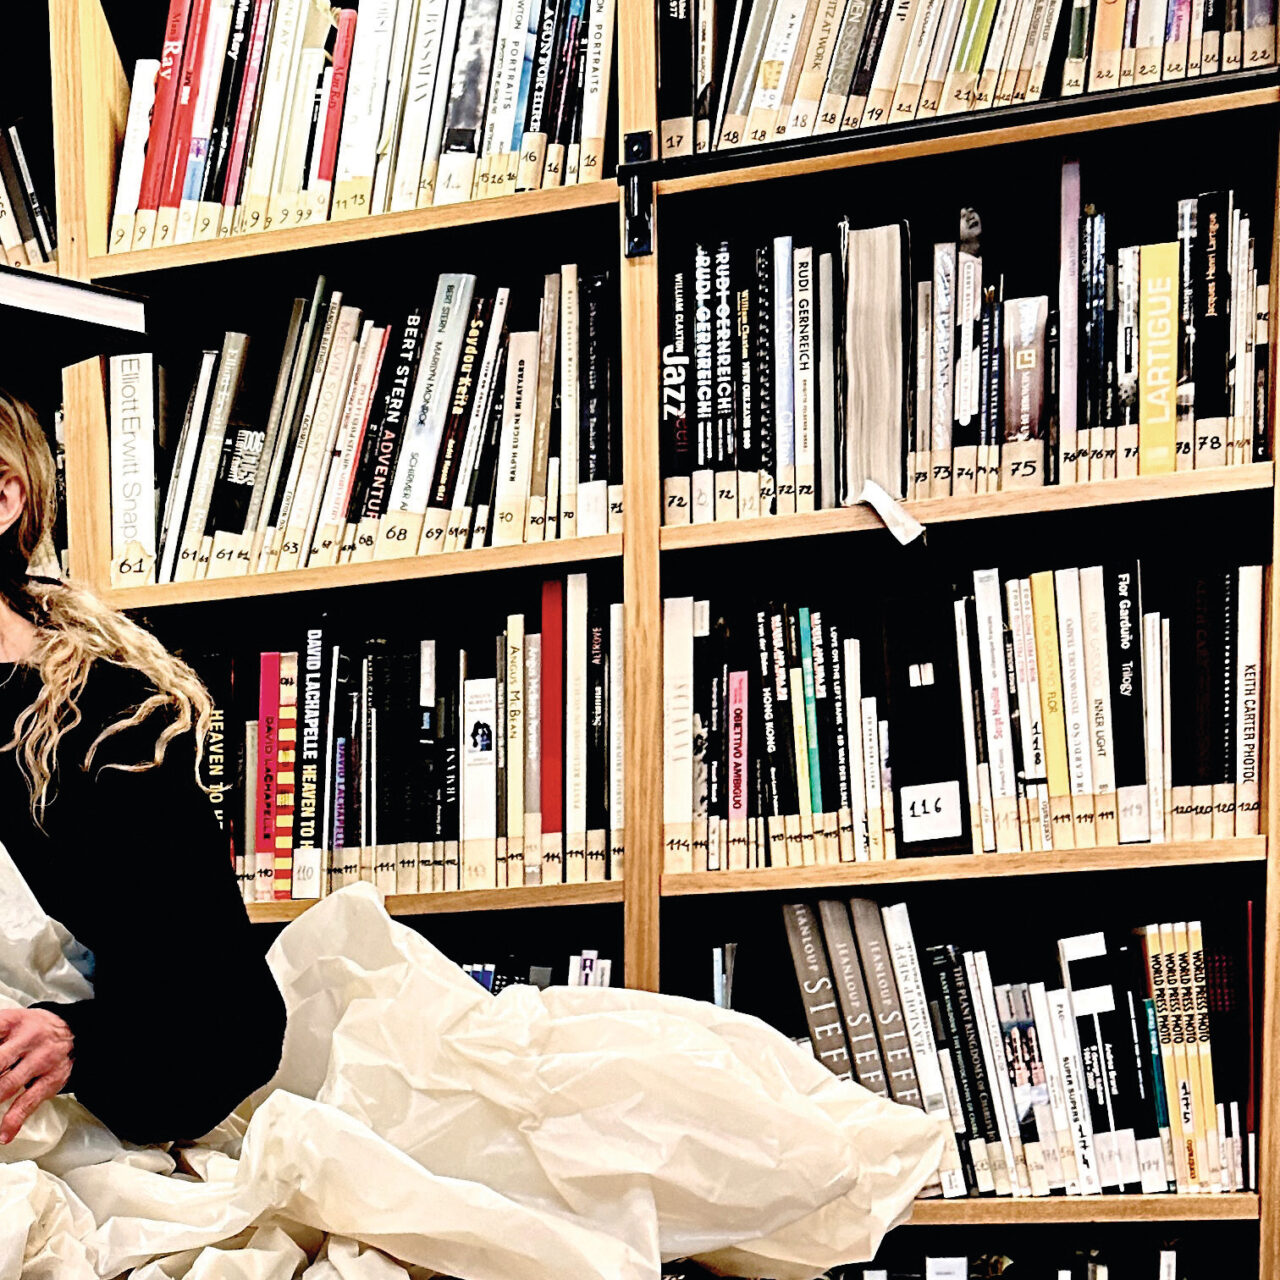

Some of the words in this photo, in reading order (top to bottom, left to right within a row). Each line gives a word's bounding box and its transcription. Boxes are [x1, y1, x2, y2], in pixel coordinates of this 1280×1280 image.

[160, 40, 181, 80] Ray
[589, 24, 602, 94] PORTRAITS
[666, 133, 684, 148] 17
[723, 130, 740, 144] 18
[674, 272, 684, 310] WILLIAM
[798, 260, 809, 292] RUDI
[400, 315, 420, 359] BERT
[674, 312, 684, 351] CLAXTON
[798, 296, 810, 372] GERNREICH
[1145, 275, 1172, 426] LARTIGUE
[121, 358, 140, 414] Elliott
[388, 364, 410, 424] STERN
[515, 359, 525, 410] MEATYARD
[662, 345, 690, 421] Jazz
[122, 416, 141, 476] Erwitt
[512, 413, 521, 449] EUGENE
[1198, 436, 1220, 451] 78
[509, 451, 518, 482] RALPH
[1011, 461, 1036, 477] 75
[386, 524, 407, 541] 68
[119, 556, 145, 574] 61
[1118, 573, 1130, 598] Flor
[1118, 600, 1131, 650] Garduño
[306, 629, 322, 671] DAVID
[510, 645, 520, 691] ANGUS
[1120, 662, 1134, 696] Trilogy
[1244, 664, 1256, 696] KEITH
[303, 673, 321, 760] LACHAPELLE
[733, 708, 743, 760] OBIETTIVO
[1243, 698, 1256, 738] CARTER
[300, 764, 317, 818] HEAVEN
[732, 762, 743, 810] AMBIGUO
[909, 796, 943, 818] 116
[299, 819, 315, 838] TO
[868, 941, 892, 1007] JEANLOUP
[1151, 953, 1164, 986] WORLD
[1155, 987, 1168, 1013] PRESS
[1158, 1014, 1171, 1044] PHOTO
[879, 1010, 920, 1101] SIEFF
